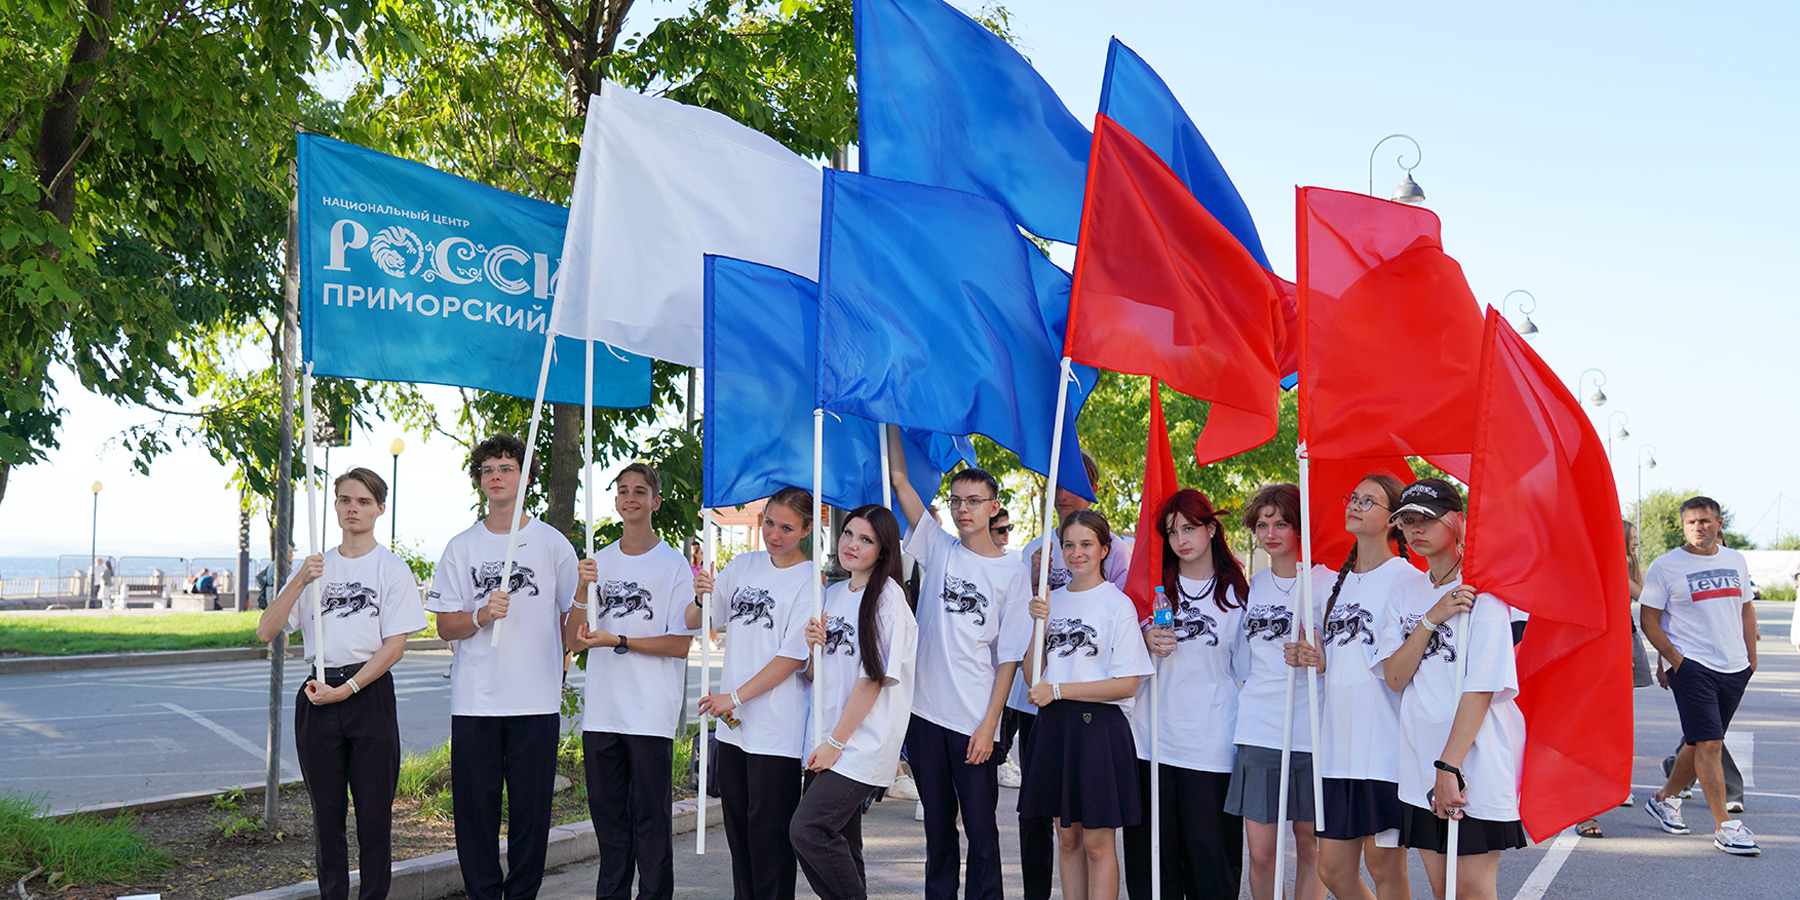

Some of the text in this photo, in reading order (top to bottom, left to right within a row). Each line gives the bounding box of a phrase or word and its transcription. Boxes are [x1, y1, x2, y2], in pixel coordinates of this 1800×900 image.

[322, 196, 470, 228] НАЦИОНАЛЬНЫЙ ЦЕНТР
[323, 218, 562, 300] РОССИ
[323, 283, 546, 334] ПРИМОРСКИЙ
